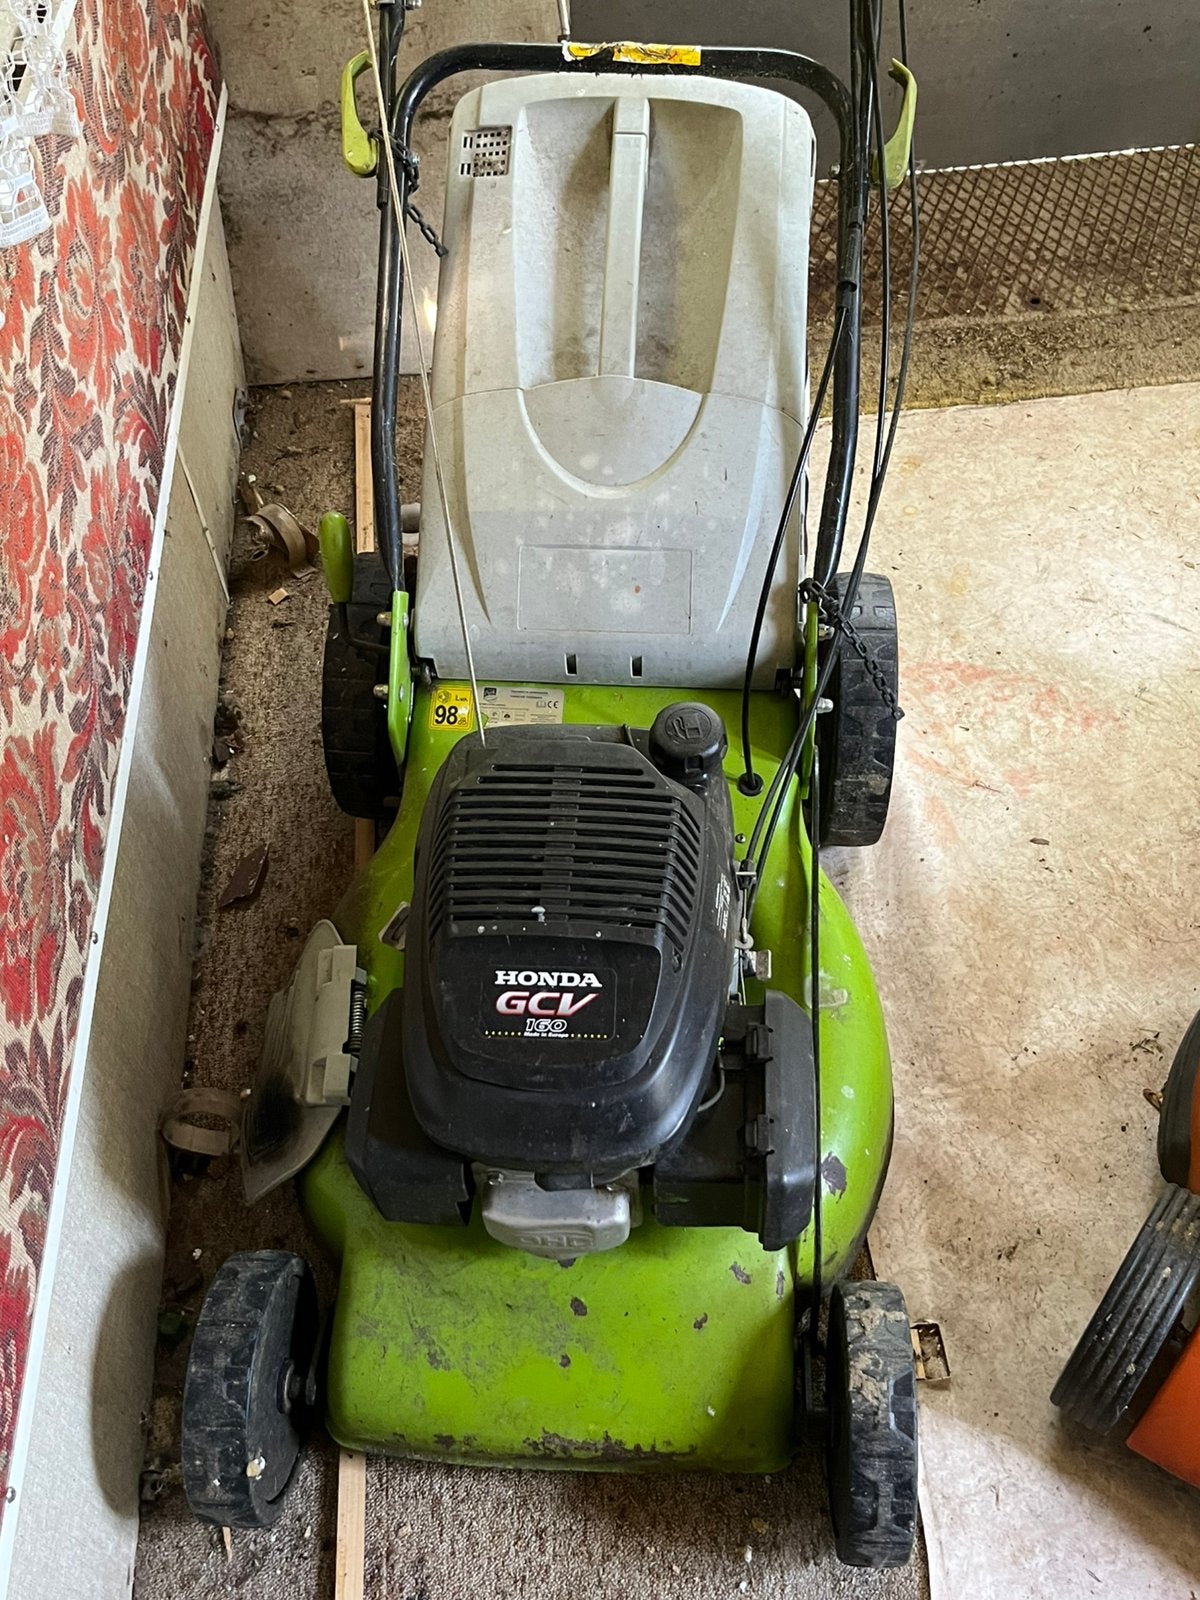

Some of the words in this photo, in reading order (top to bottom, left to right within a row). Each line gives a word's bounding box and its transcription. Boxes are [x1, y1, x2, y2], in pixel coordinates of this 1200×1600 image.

[435, 704, 458, 725] 98
[494, 970, 603, 988] HONDA
[495, 990, 600, 1017] GCV
[525, 1018, 568, 1033] 160
